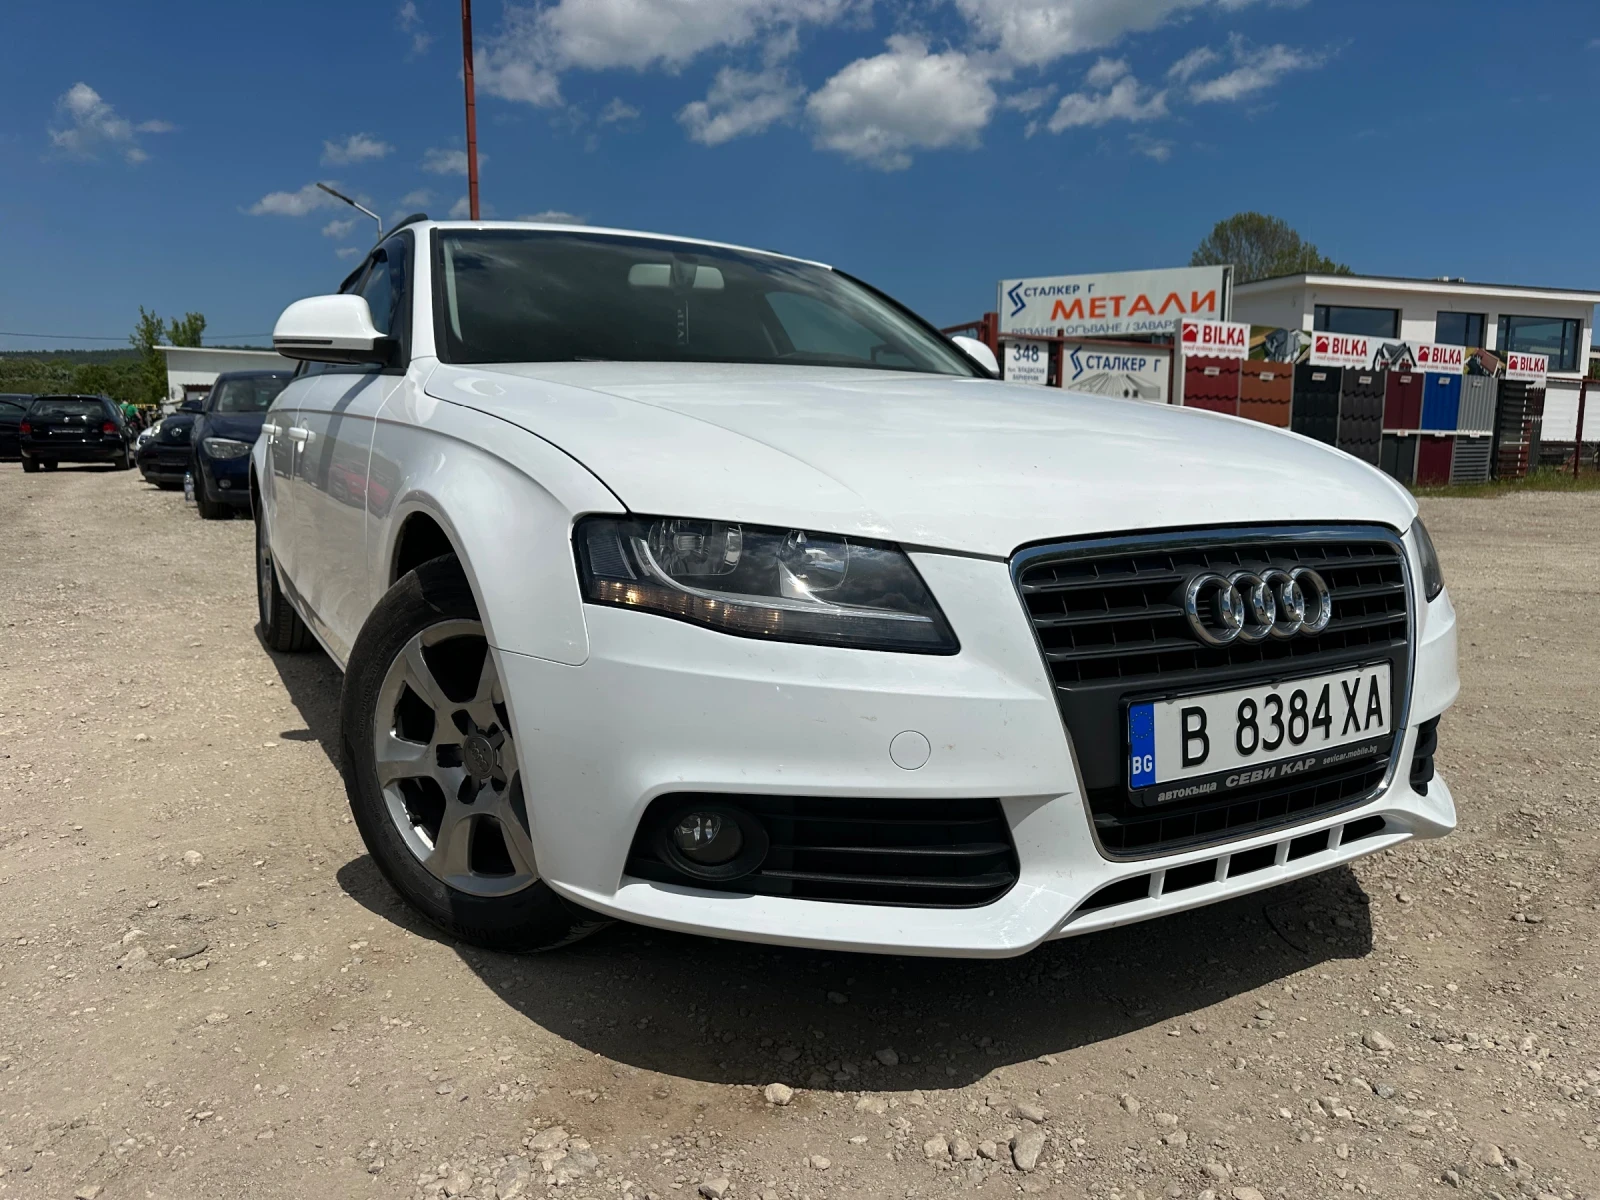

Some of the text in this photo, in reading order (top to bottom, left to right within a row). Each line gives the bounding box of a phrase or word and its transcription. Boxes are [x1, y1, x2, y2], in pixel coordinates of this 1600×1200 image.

[1024, 284, 1080, 297] СТАЛКЕР
[1051, 290, 1216, 321] МЕТАЛИ
[1203, 325, 1245, 346] BILKA
[1013, 344, 1039, 362] 348
[1332, 338, 1368, 357] BILKA
[1432, 347, 1462, 365] BILKA
[1086, 355, 1161, 372] СТАЛКЕР Г
[1520, 356, 1545, 373] BILKA
[1181, 674, 1384, 769] B 8384 XA
[1132, 754, 1153, 775] BG
[1157, 744, 1378, 802] автокъща СЕВИ КАР sevicar.mobile.bg
